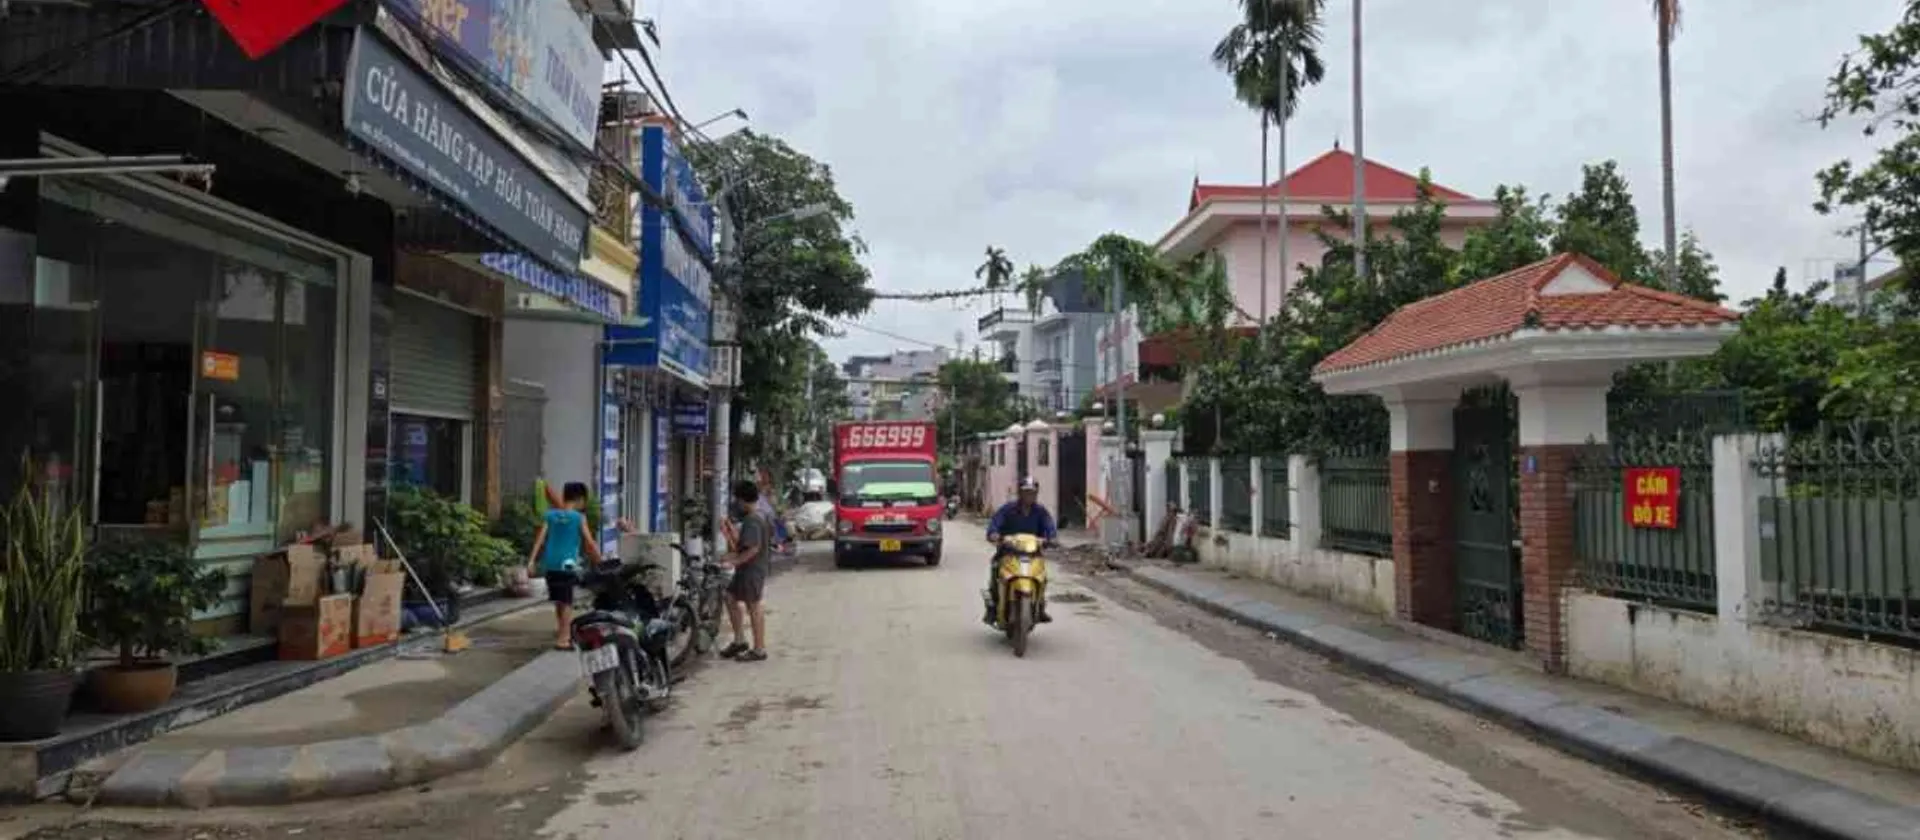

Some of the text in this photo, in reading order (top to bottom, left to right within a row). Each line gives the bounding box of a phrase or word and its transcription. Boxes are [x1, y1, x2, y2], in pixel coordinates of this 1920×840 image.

[414, 98, 463, 164] HÀNG
[465, 142, 494, 187] TẠP
[850, 426, 925, 448] 666999
[1636, 470, 1668, 495] CẤM
[1633, 499, 1672, 525] ĐỖ XE
